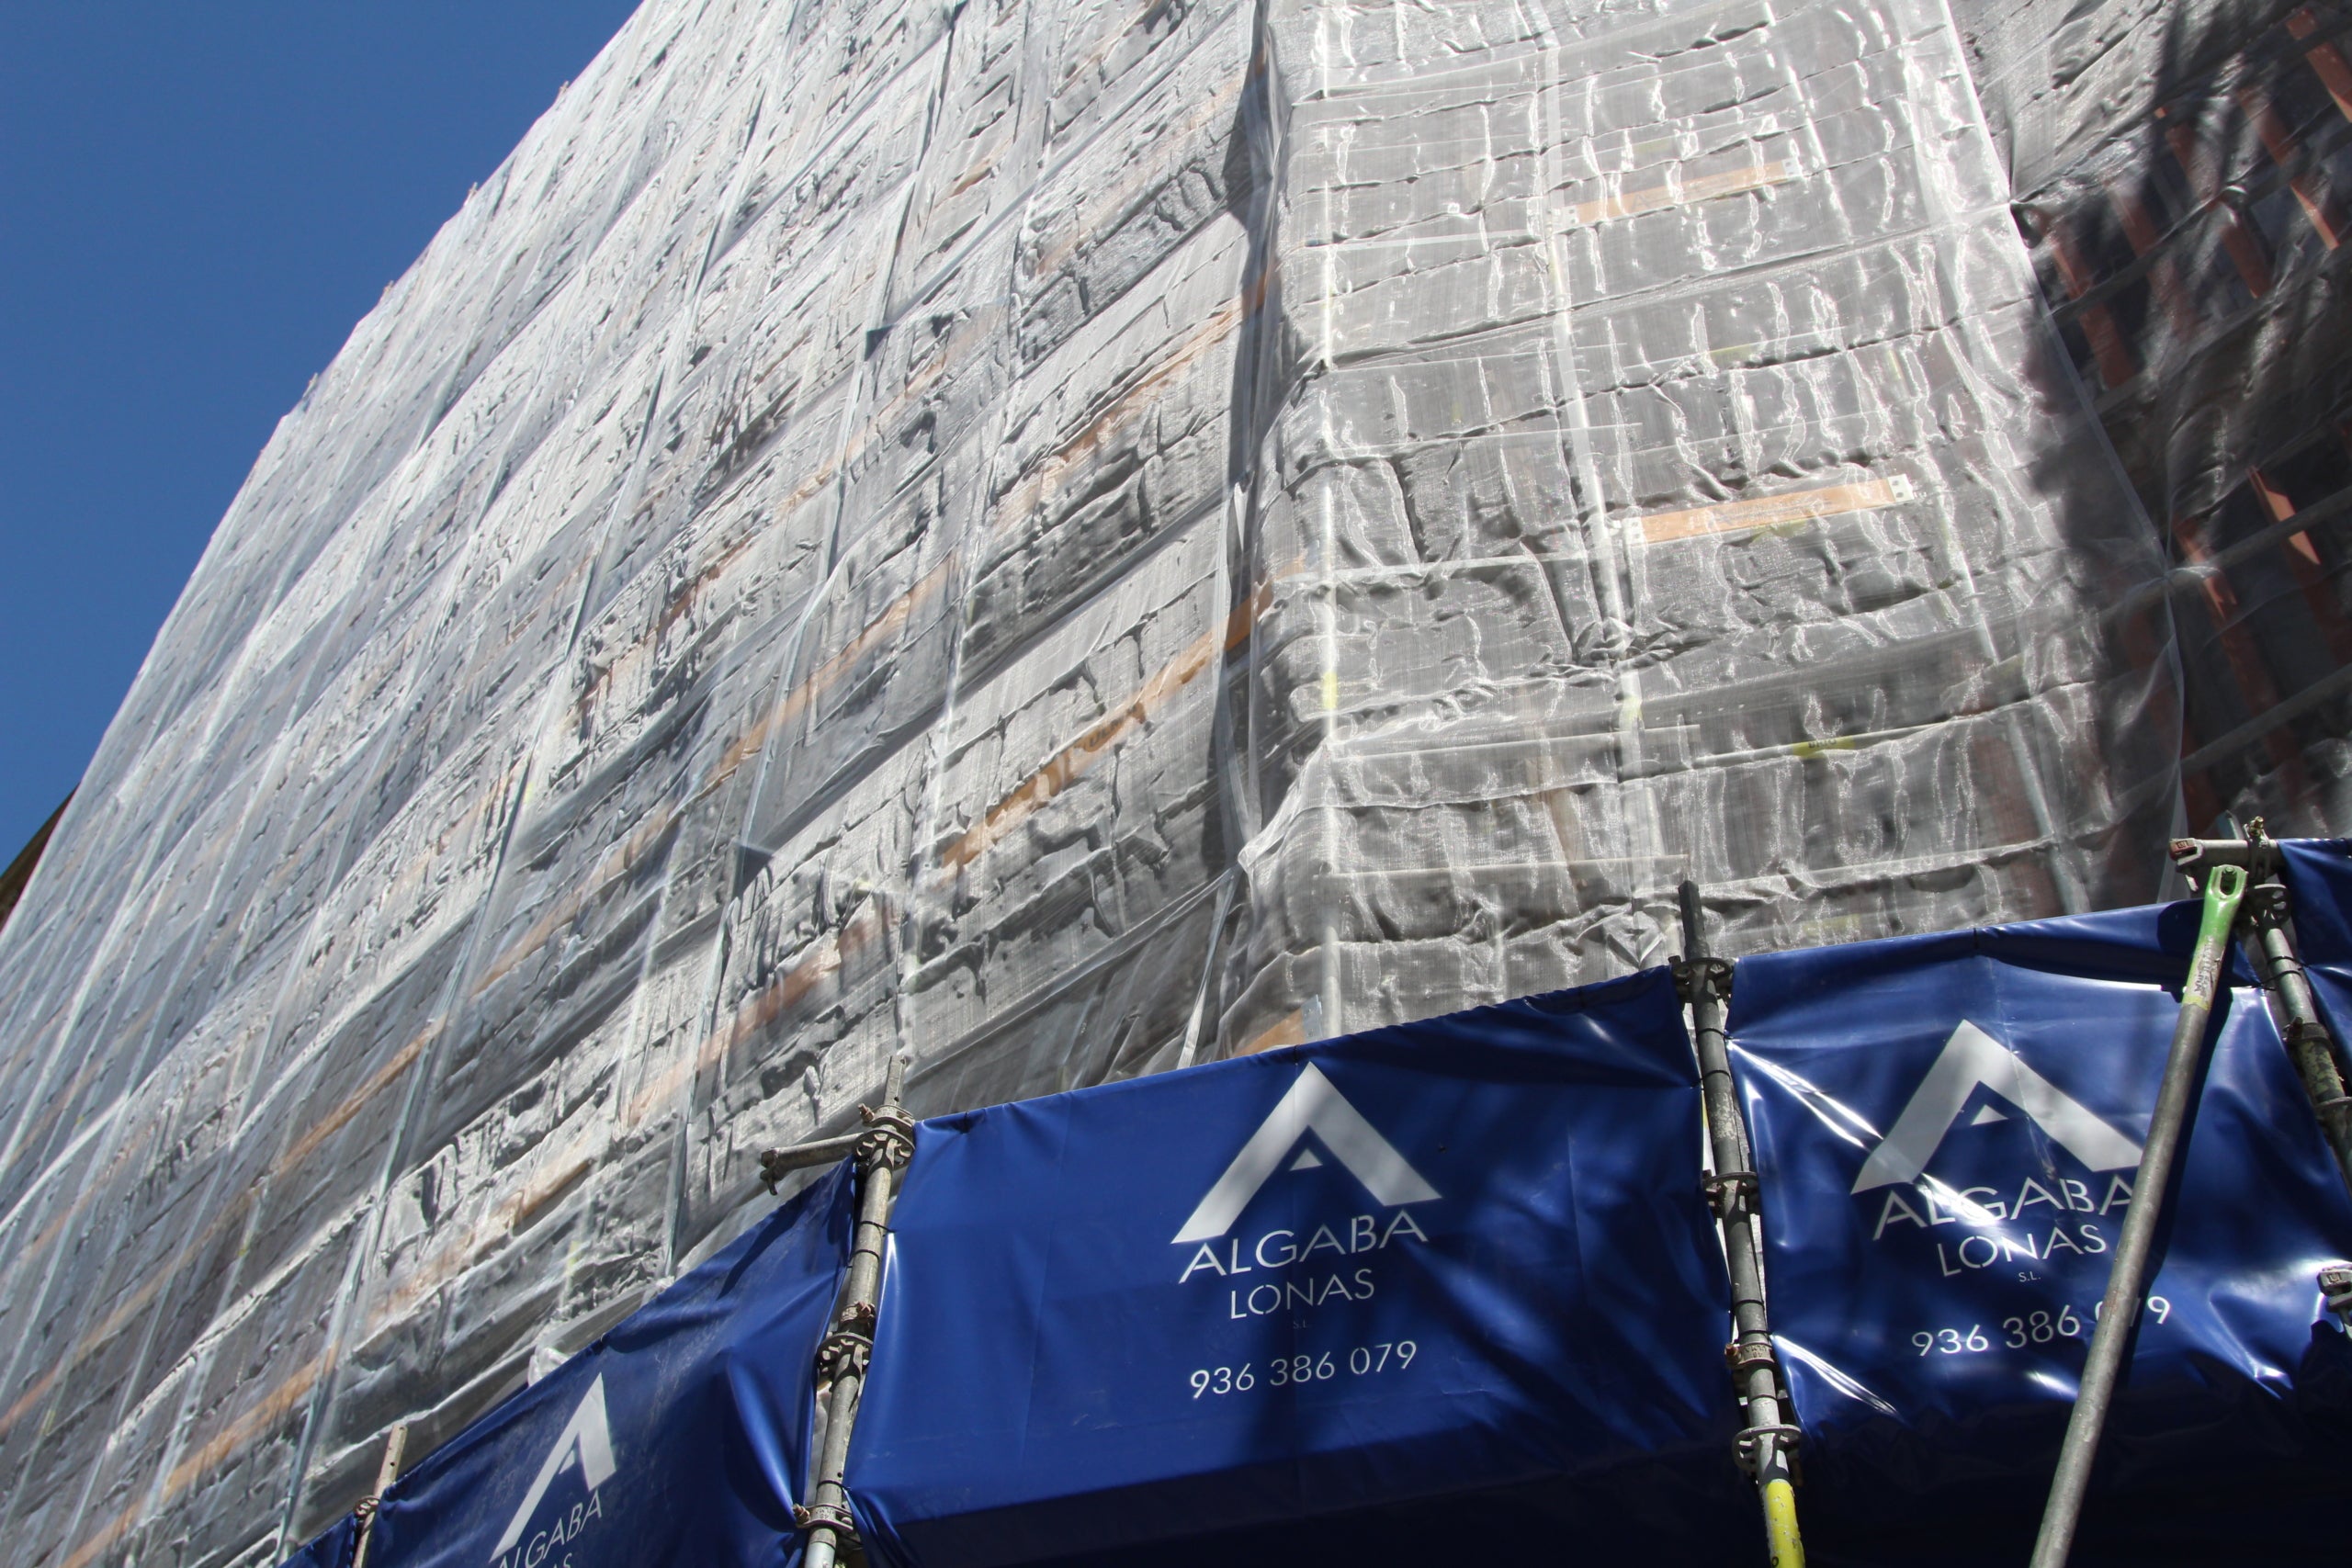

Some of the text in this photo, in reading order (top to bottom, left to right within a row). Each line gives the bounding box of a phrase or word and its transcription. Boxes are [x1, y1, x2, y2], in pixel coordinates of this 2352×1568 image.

[1872, 1175, 2132, 1240] ALGABA
[1178, 1209, 1429, 1284] ALGABA
[1938, 1224, 2106, 1277] LONAS
[1230, 1269, 1374, 1319] LONAS
[2018, 1271, 2041, 1282] S.L.
[1912, 1325, 1989, 1357] 936
[2003, 1304, 2081, 1348] 386
[1190, 1340, 1417, 1400] 936 386 079
